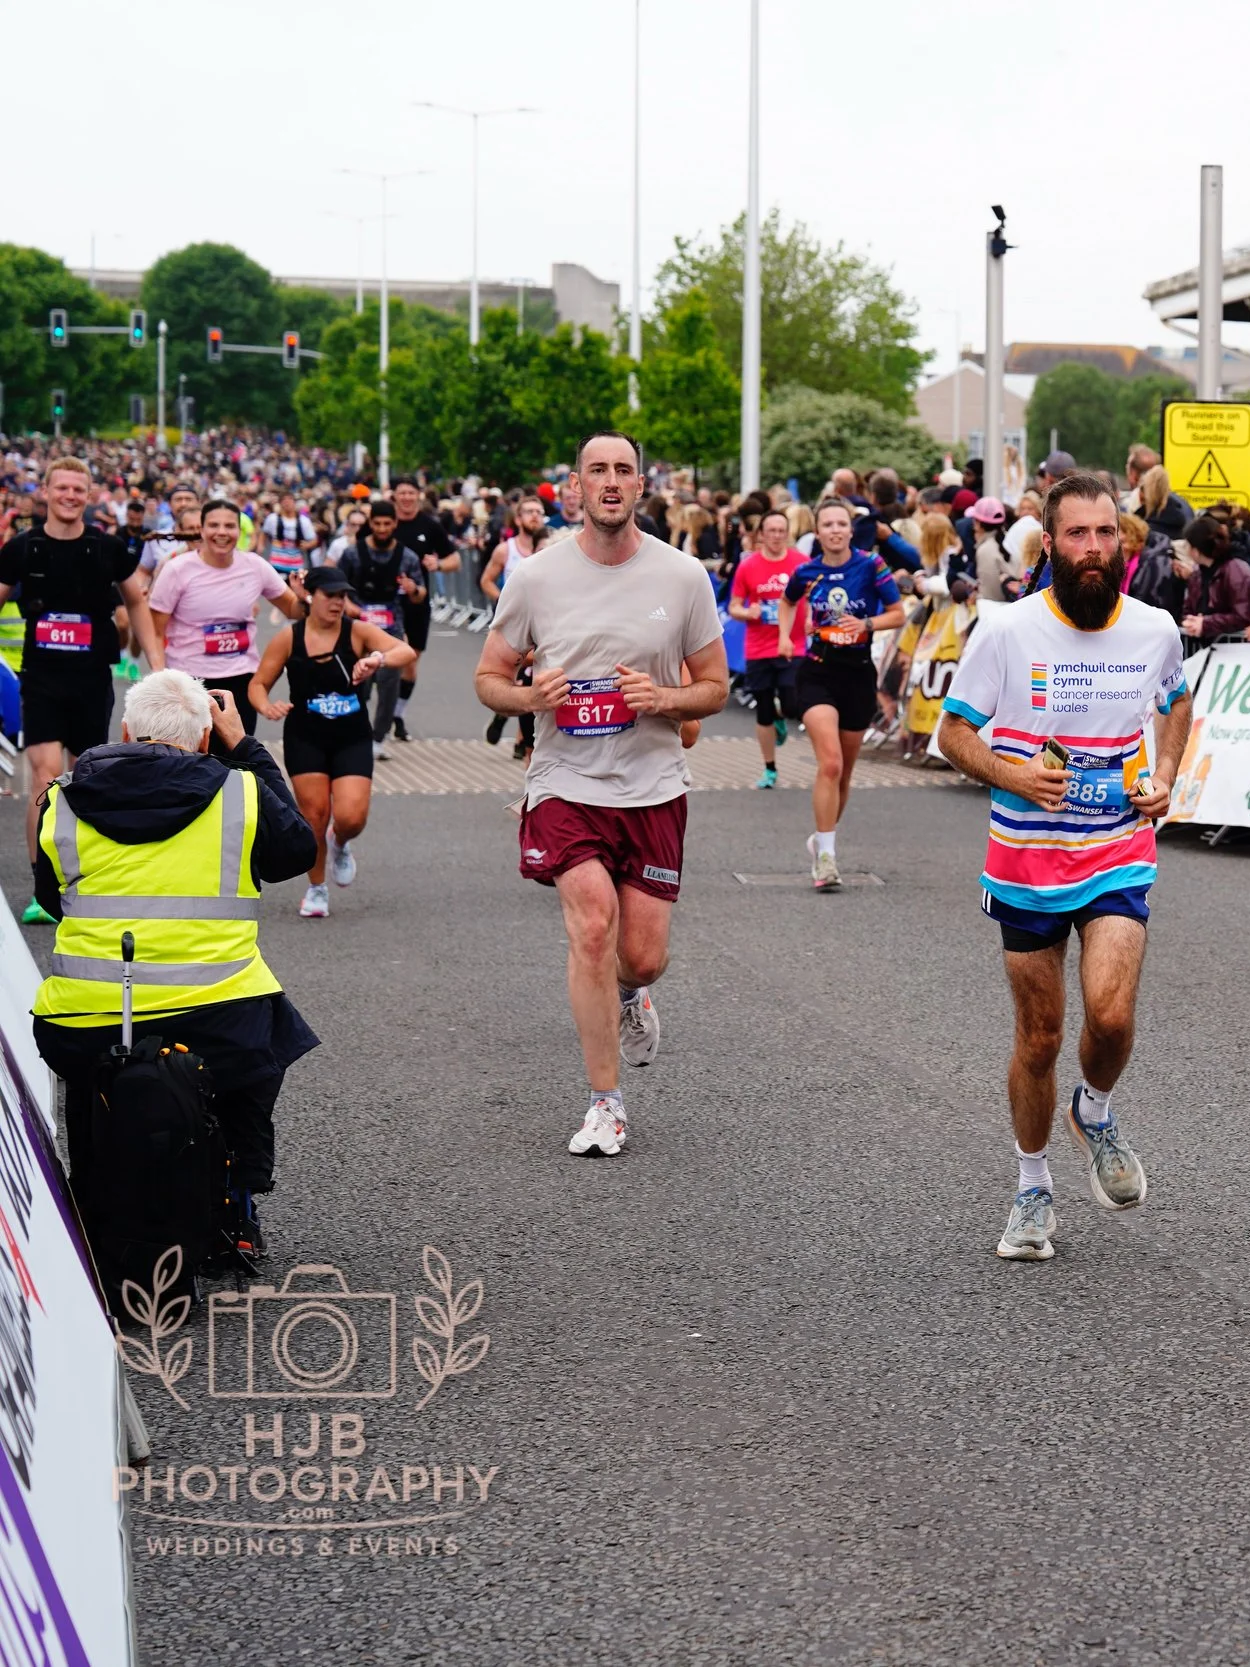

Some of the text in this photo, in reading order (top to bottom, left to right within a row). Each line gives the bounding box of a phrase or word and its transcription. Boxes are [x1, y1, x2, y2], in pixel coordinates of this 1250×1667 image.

[1182, 410, 1240, 420] Runners on
[1186, 421, 1234, 431] Road this
[1192, 433, 1229, 443] Sunday
[51, 628, 75, 643] 611
[218, 638, 239, 652] 222
[1053, 662, 1147, 674] ymchwil canser
[1053, 677, 1092, 688] cymru
[1053, 689, 1141, 700] cancer research
[563, 697, 593, 706] ALLUM
[1053, 703, 1088, 713] wales
[578, 705, 614, 724] 617
[573, 726, 622, 735] #RUNSWANSEA
[1208, 724, 1232, 740] Now
